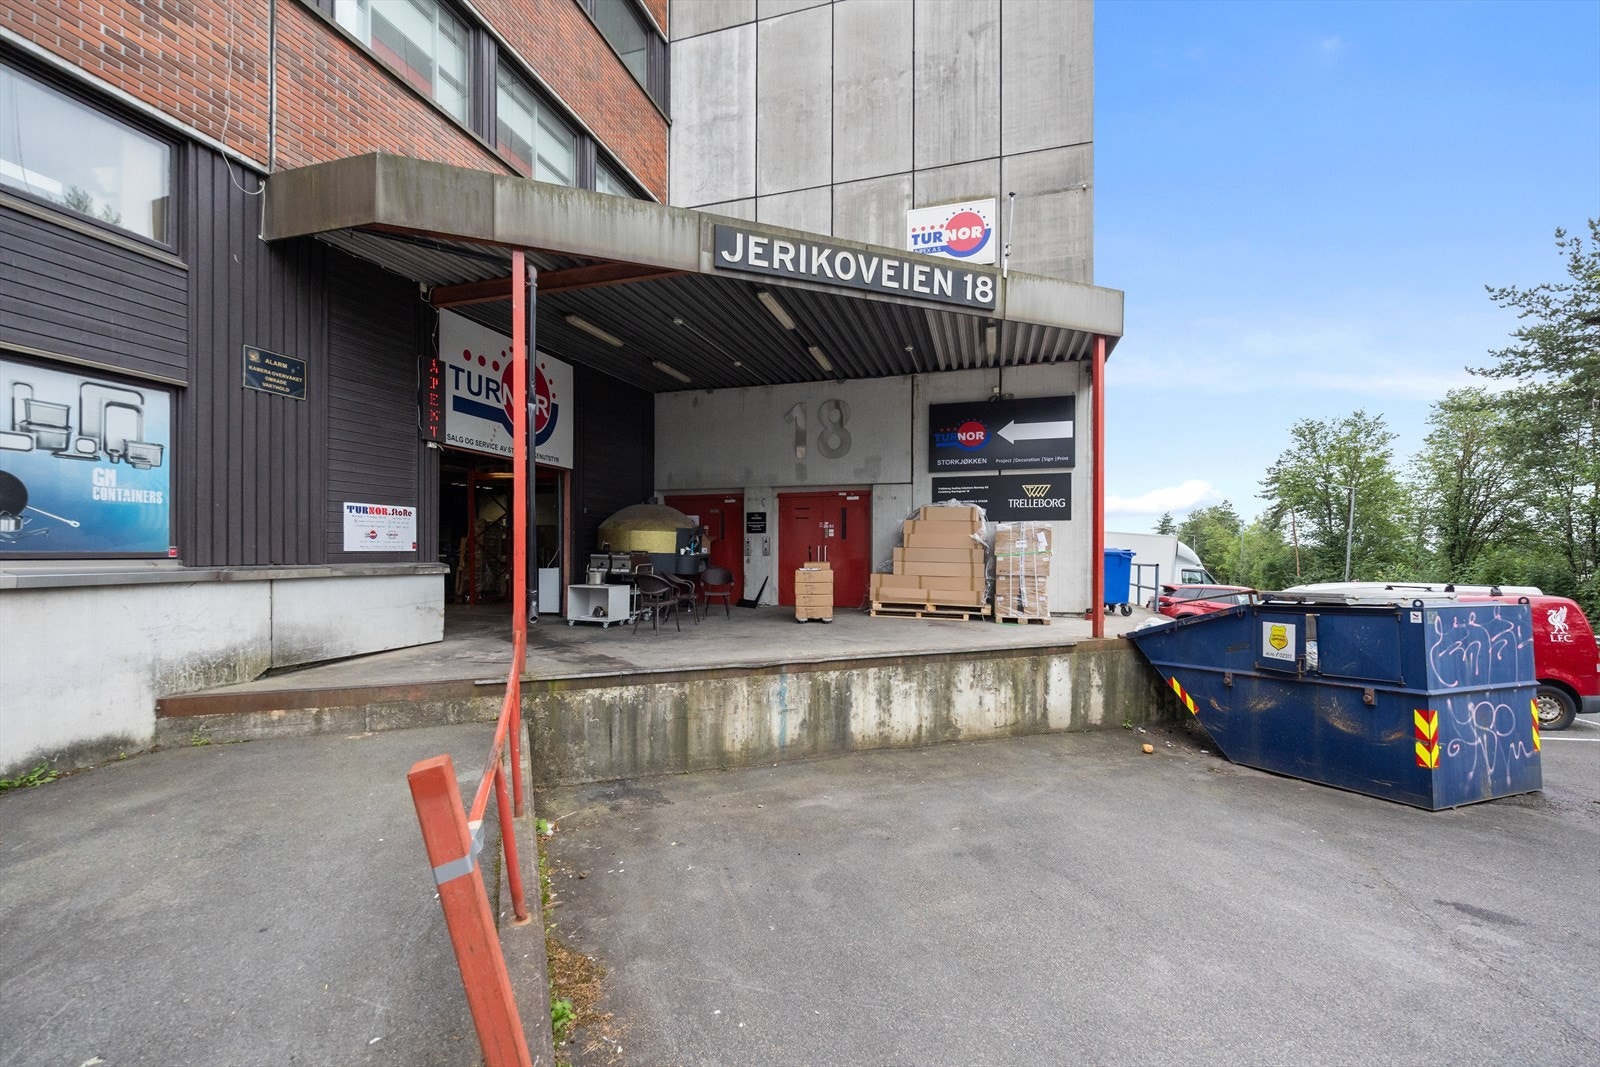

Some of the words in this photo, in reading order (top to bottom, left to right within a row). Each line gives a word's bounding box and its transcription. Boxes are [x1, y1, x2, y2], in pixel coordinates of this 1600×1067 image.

[912, 226, 983, 246] TURNOR
[721, 233, 952, 297] JERIKOVEIEN
[963, 273, 994, 303] 18
[265, 358, 288, 369] ALARM
[448, 363, 550, 418] TURNR
[784, 399, 852, 459] 18
[934, 431, 985, 442] TURNOR
[446, 433, 464, 443] SALG
[464, 437, 474, 446] OG
[475, 439, 499, 451] SERVICE
[499, 445, 507, 453] AV
[937, 457, 988, 466] STORKJØKKEN
[92, 467, 117, 487] GN
[92, 486, 163, 504] CONTAINERS
[1008, 498, 1066, 508] TRELLEBORG
